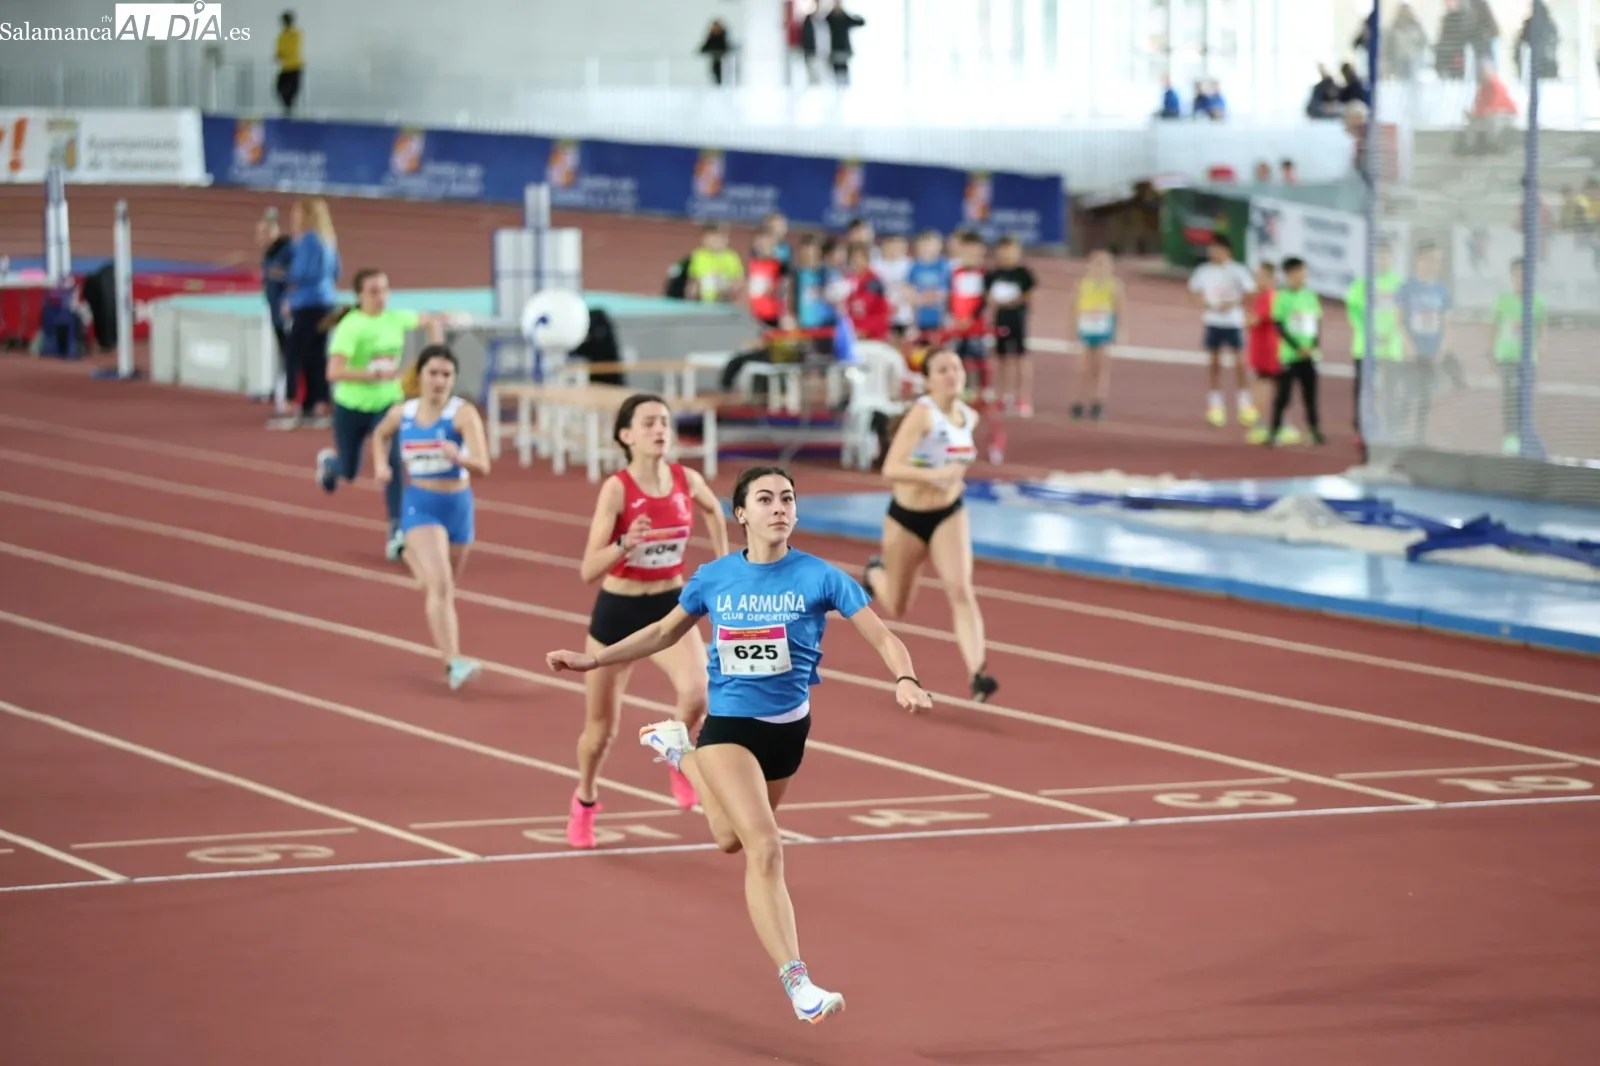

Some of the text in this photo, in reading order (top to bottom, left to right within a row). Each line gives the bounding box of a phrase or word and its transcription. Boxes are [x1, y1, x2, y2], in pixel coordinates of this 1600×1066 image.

[716, 591, 806, 613] LA ARMUÑA
[721, 612, 800, 622] CLUB DEPORTIVO
[734, 644, 778, 660] 625
